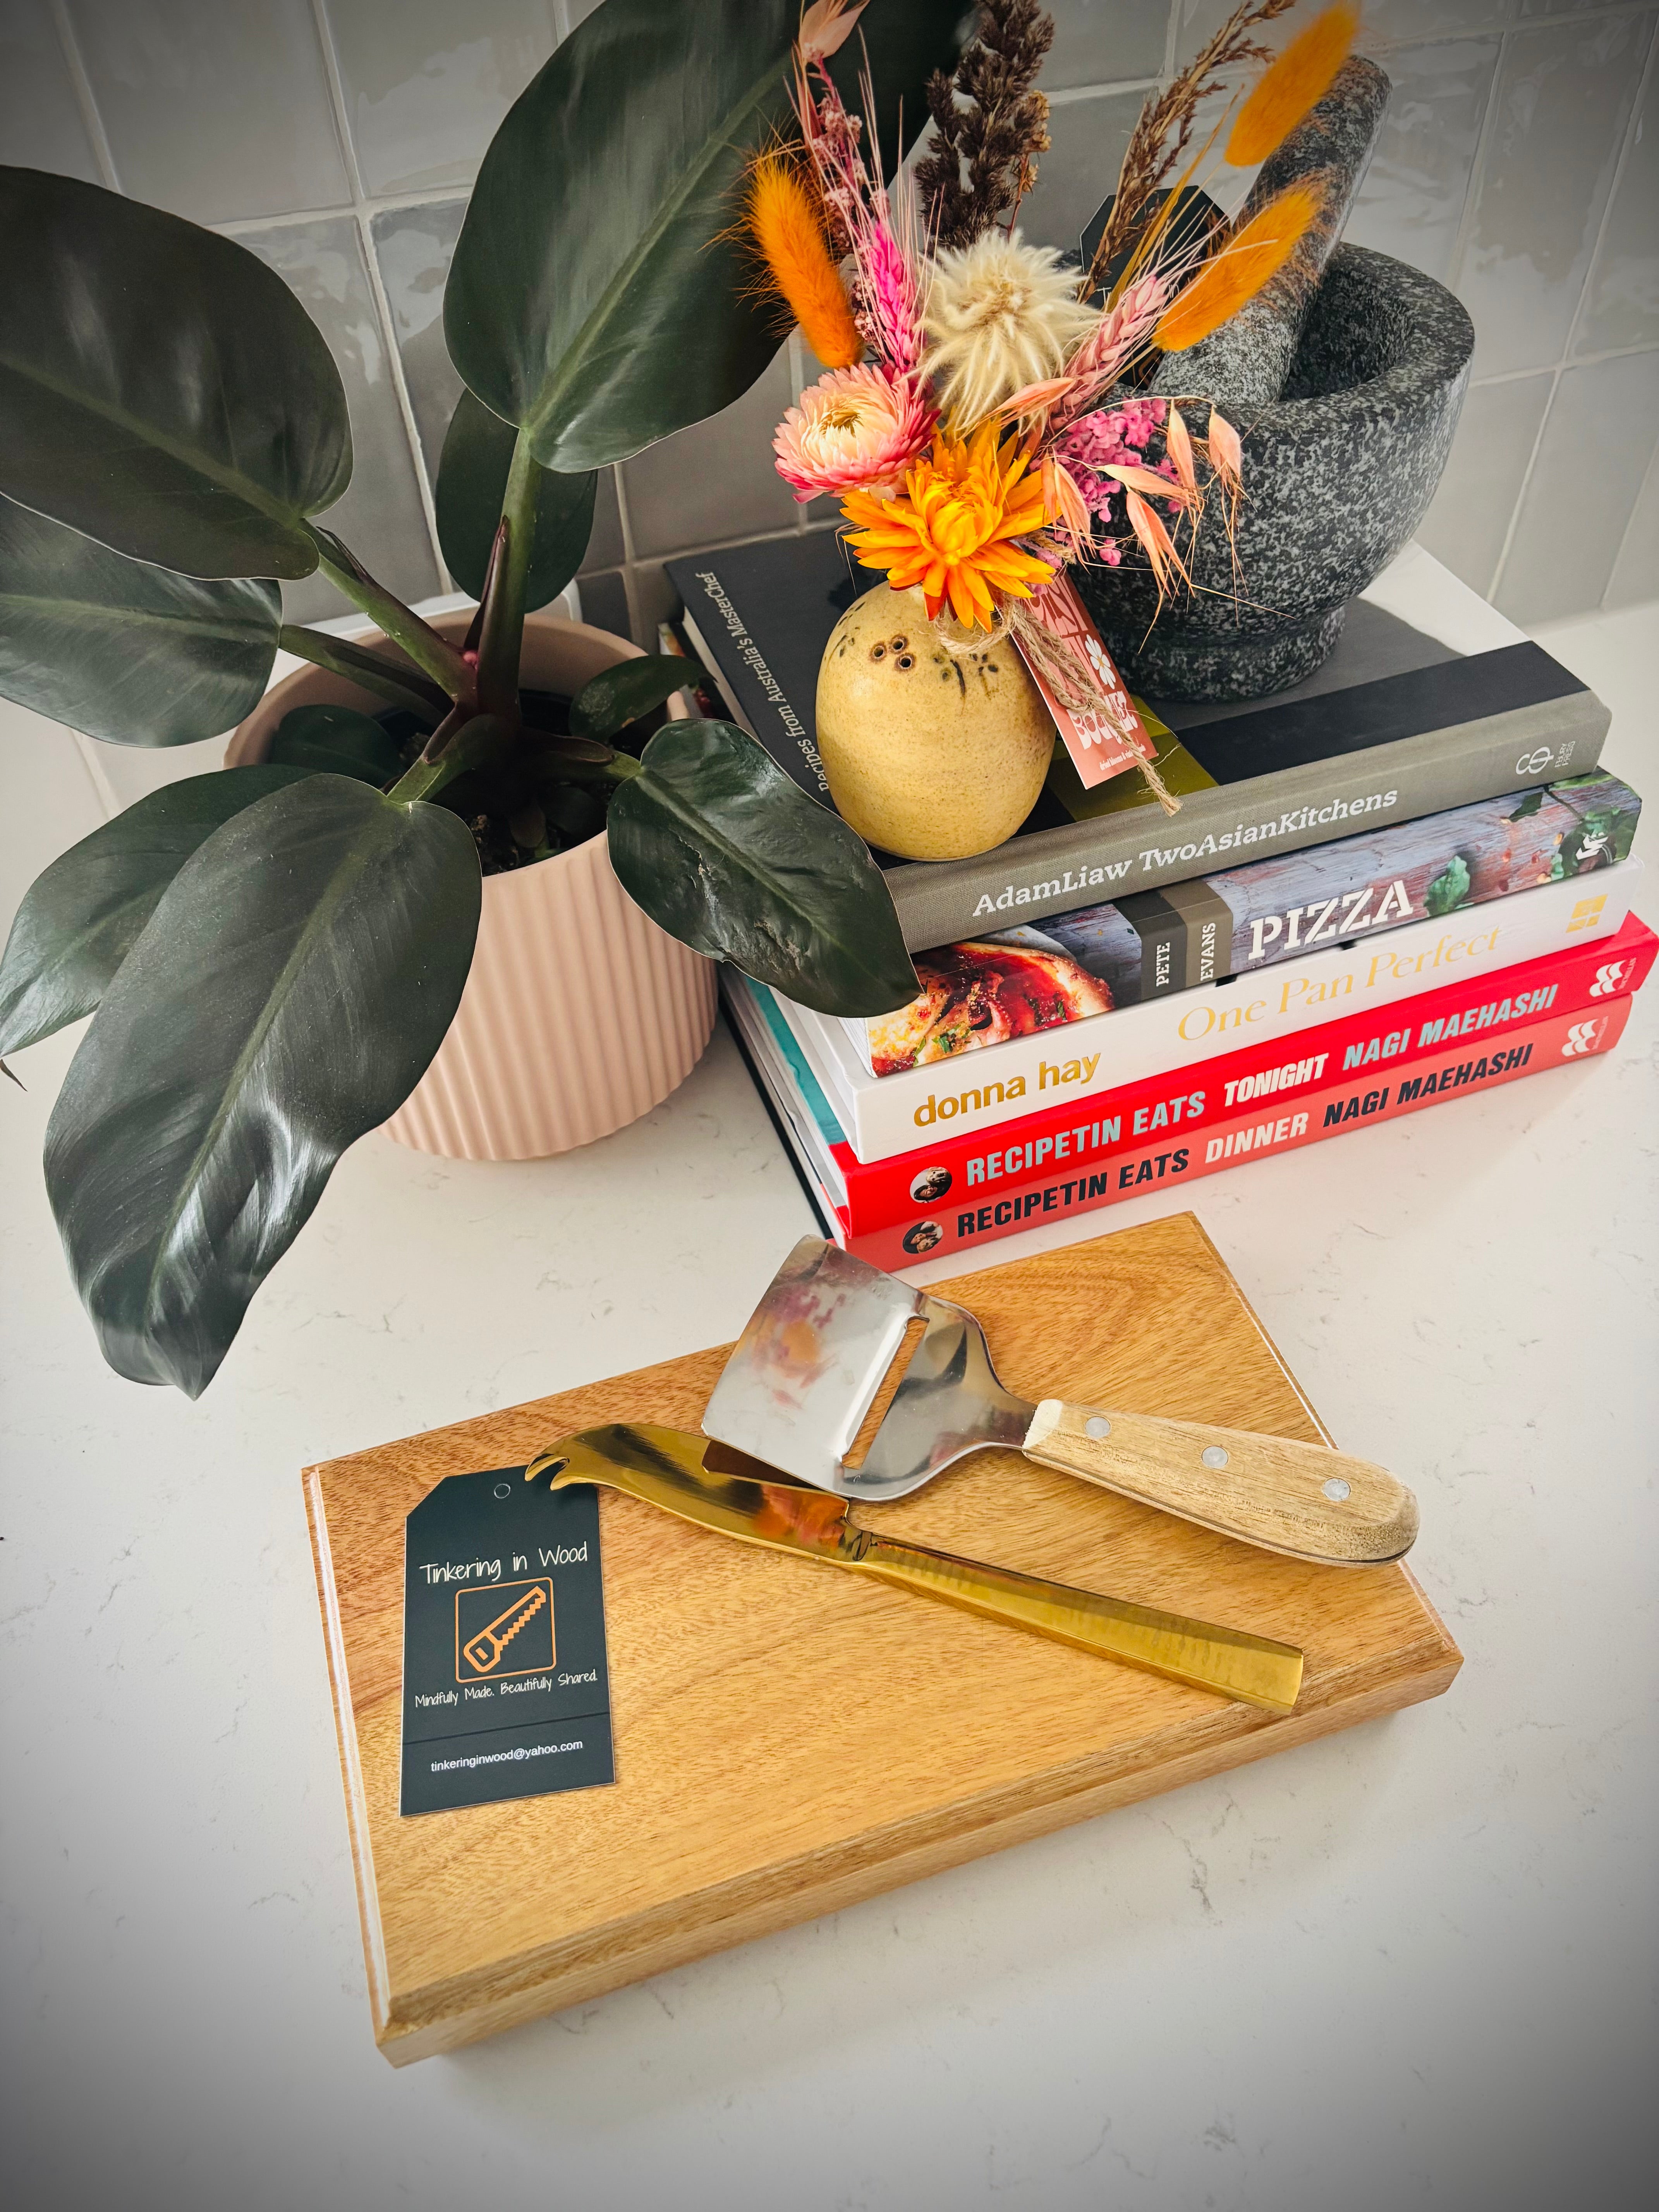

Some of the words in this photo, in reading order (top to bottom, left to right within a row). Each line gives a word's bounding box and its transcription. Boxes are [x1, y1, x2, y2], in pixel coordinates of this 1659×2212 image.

[695, 572, 747, 637] MasterChef
[737, 637, 787, 703] Australia's
[778, 704, 805, 737] from
[798, 739, 829, 791] Recipes
[972, 859, 1132, 917] AdamLiaw
[1139, 790, 1398, 871] TwoAsianKitchens
[1200, 922, 1216, 981] EVANS
[1248, 880, 1413, 960] PIZZA
[1156, 942, 1170, 987] PETE
[1178, 1000, 1267, 1040] One
[1278, 974, 1353, 1015] Pan
[1365, 925, 1502, 989] Perfect
[914, 1076, 1026, 1127] donna
[1039, 1052, 1101, 1091] hay
[967, 1116, 1121, 1187] RECIPETIN
[1133, 1091, 1206, 1136] EATS
[1224, 1053, 1329, 1107] TONIGHT
[1343, 1032, 1409, 1070] NAGI
[1417, 984, 1558, 1049] MAEHASHI
[957, 1172, 1106, 1237] RECIPETIN
[1118, 1148, 1189, 1189] EATS
[1205, 1112, 1309, 1163] DINNER
[1323, 1087, 1389, 1127] NAGI
[1396, 1043, 1534, 1104] MAEHASHI
[419, 1557, 501, 1583] Tinkering
[513, 1552, 527, 1571] in
[538, 1541, 587, 1566] Wood
[415, 1691, 458, 1707] Mindfully
[465, 1686, 495, 1700] Made.
[501, 1676, 552, 1695] Beautifully
[559, 1669, 598, 1686] Shared.
[431, 1740, 583, 1772] tinkeringinwood@yahoo.com
